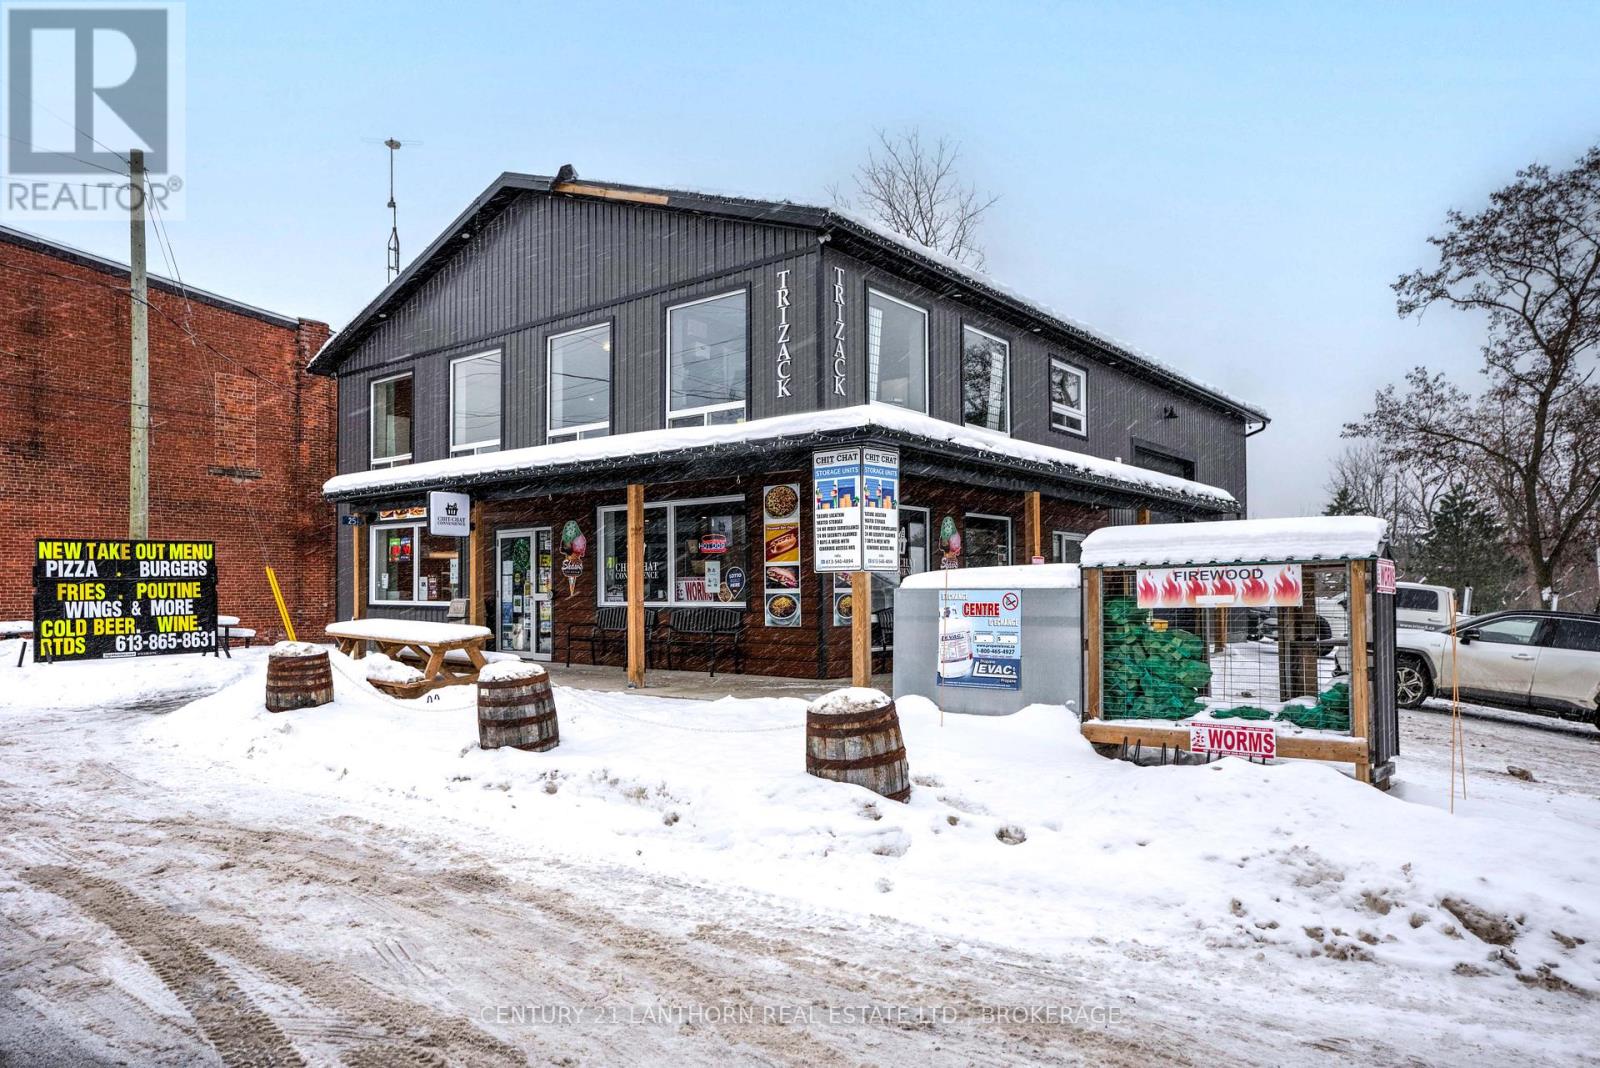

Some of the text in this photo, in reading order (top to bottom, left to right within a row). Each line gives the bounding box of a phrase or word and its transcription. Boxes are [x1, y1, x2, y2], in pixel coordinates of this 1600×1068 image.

[776, 269, 792, 398] TRIZACK
[833, 266, 846, 396] TRIZACK
[815, 453, 858, 464] CHIT CHAT
[865, 453, 897, 464] CHIT CHAT
[39, 542, 213, 560] NEW TAKE OUT MENU
[46, 561, 208, 577] PIZZA BURGERS
[1174, 568, 1263, 582] FIREWOOD
[57, 582, 201, 600] FRIES POUTINE
[65, 599, 194, 618] WINGS & MORE
[963, 603, 999, 616] CENTRE
[41, 619, 87, 637] COLD
[115, 631, 216, 652] 613-865-8631
[1208, 728, 1275, 753] WORMS
